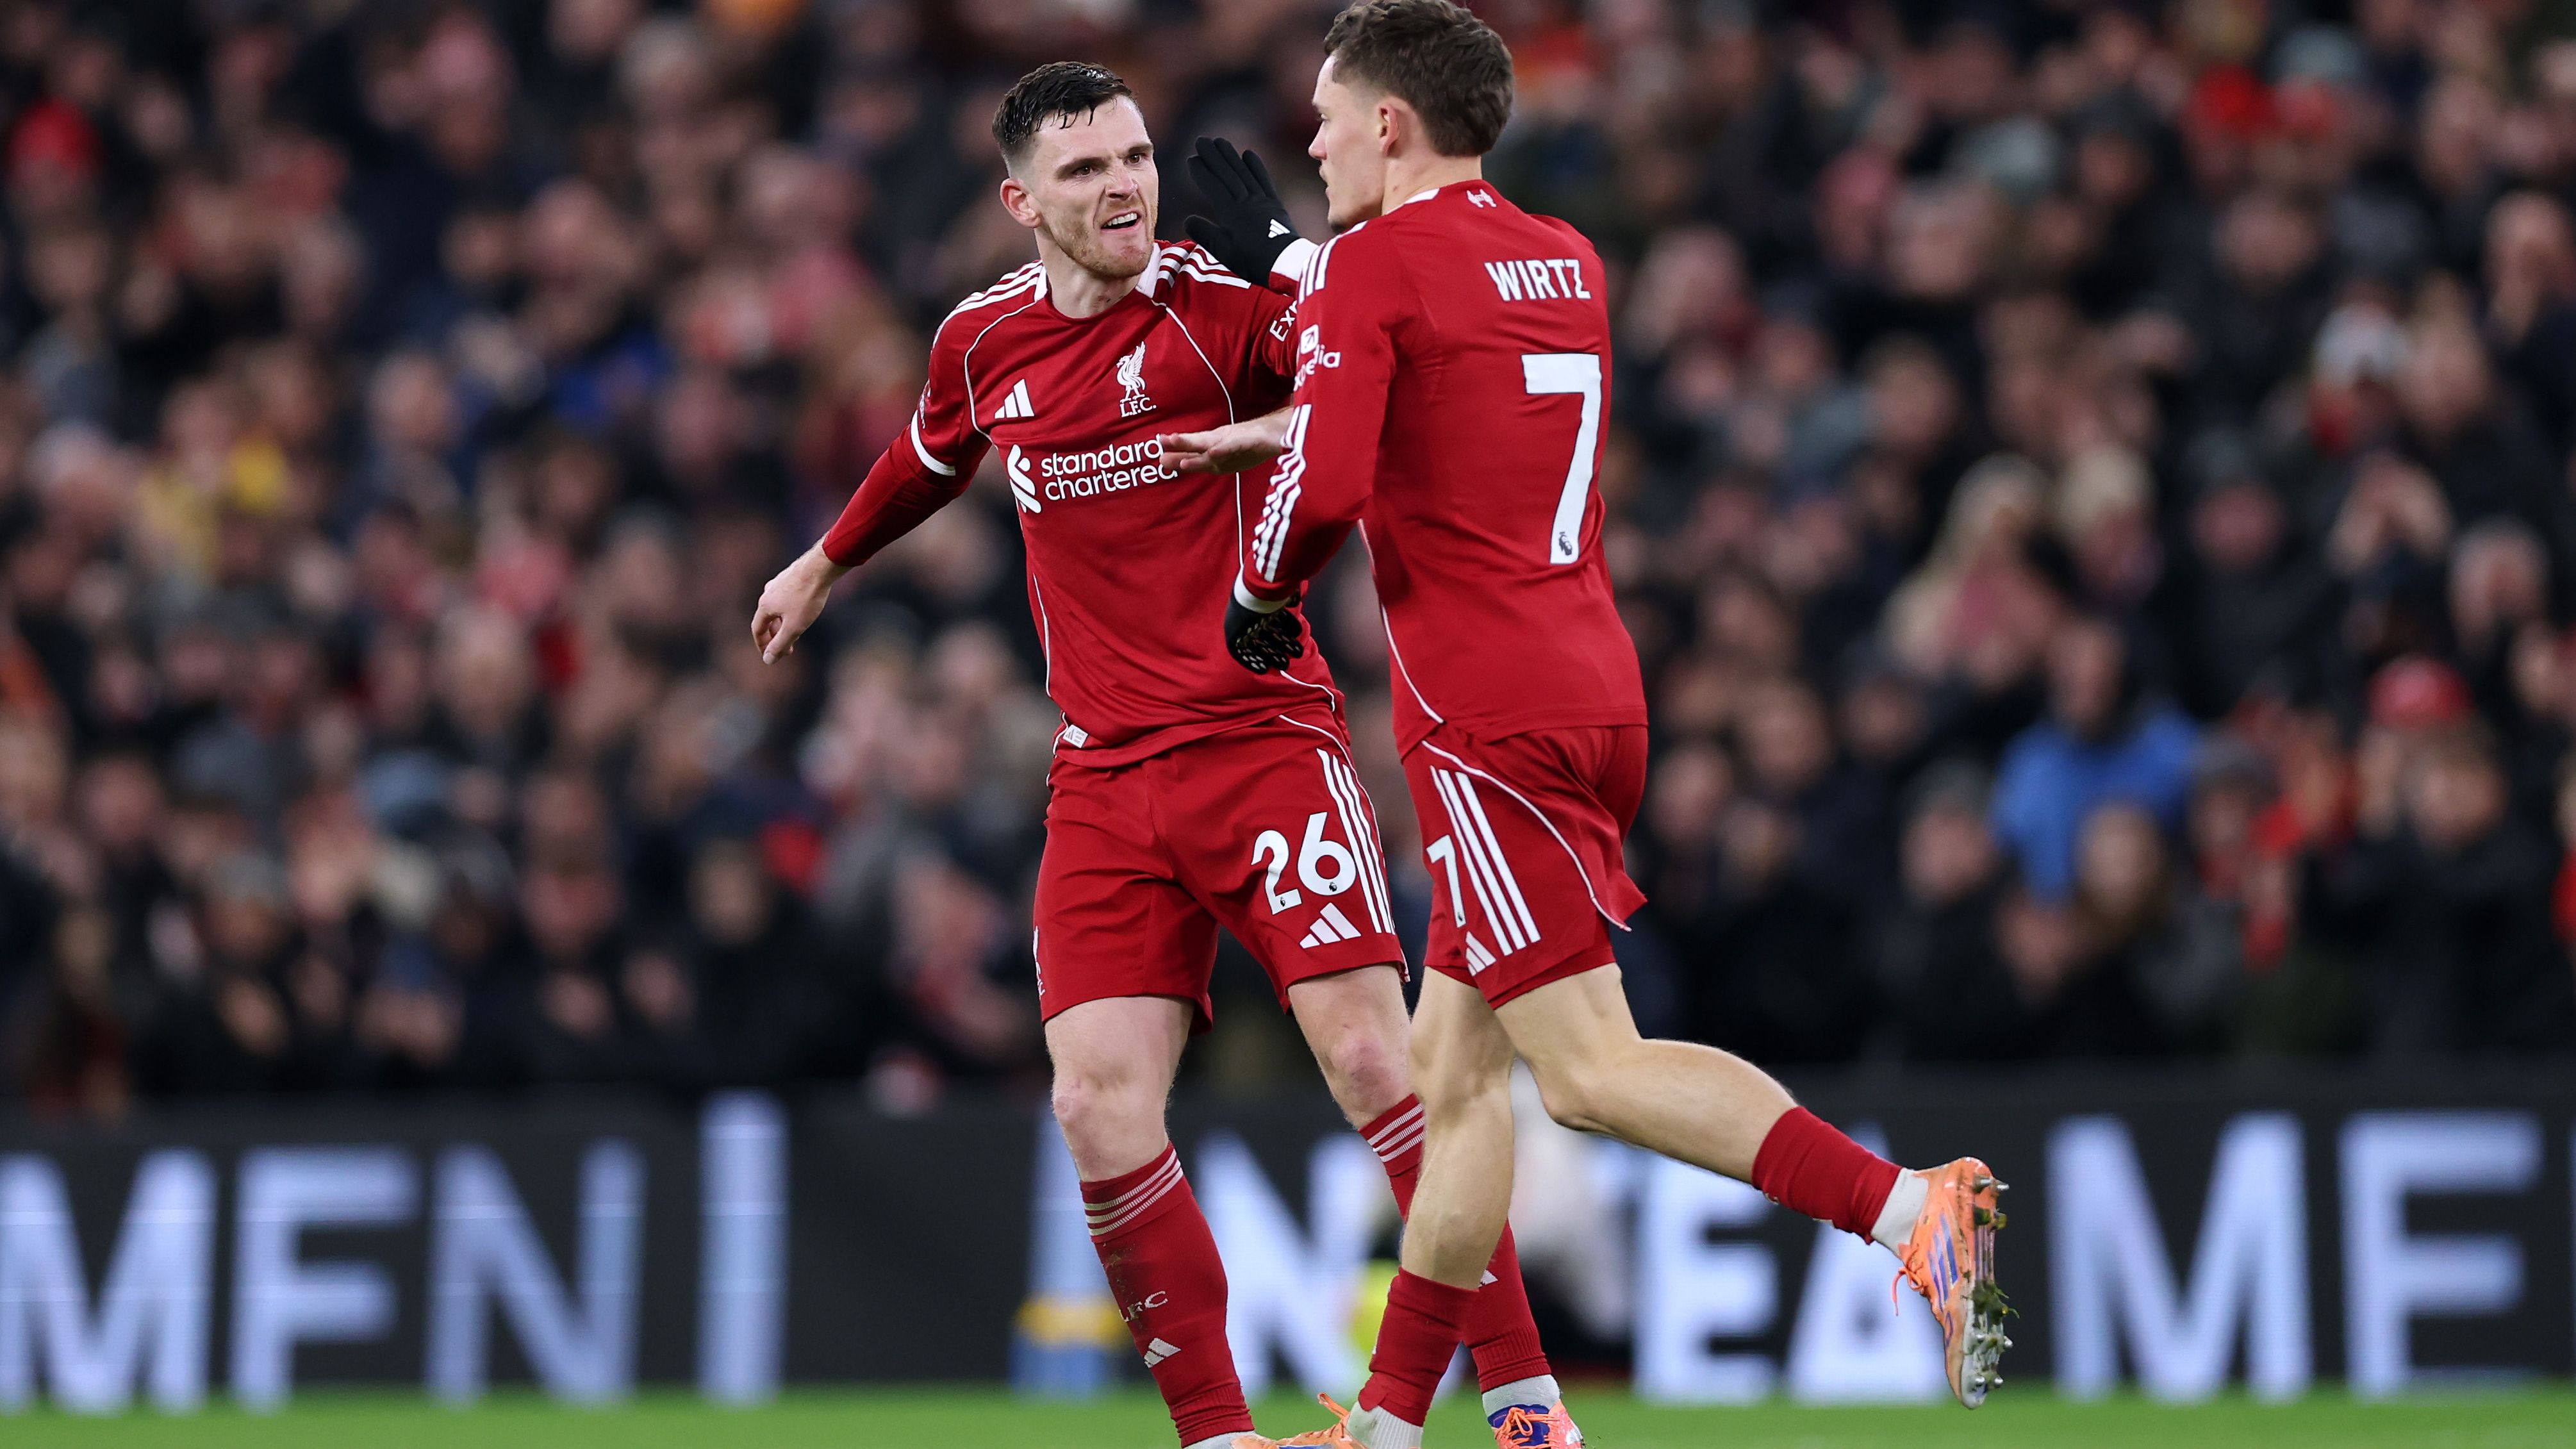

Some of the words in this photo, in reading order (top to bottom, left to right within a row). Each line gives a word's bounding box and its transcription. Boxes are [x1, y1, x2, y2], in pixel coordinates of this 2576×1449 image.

[1485, 259, 1591, 301] WIRTZ
[1041, 433, 1164, 477] standard
[1521, 352, 1602, 565] 7
[1251, 812, 1357, 915] 26
[1426, 834, 1467, 929] 7
